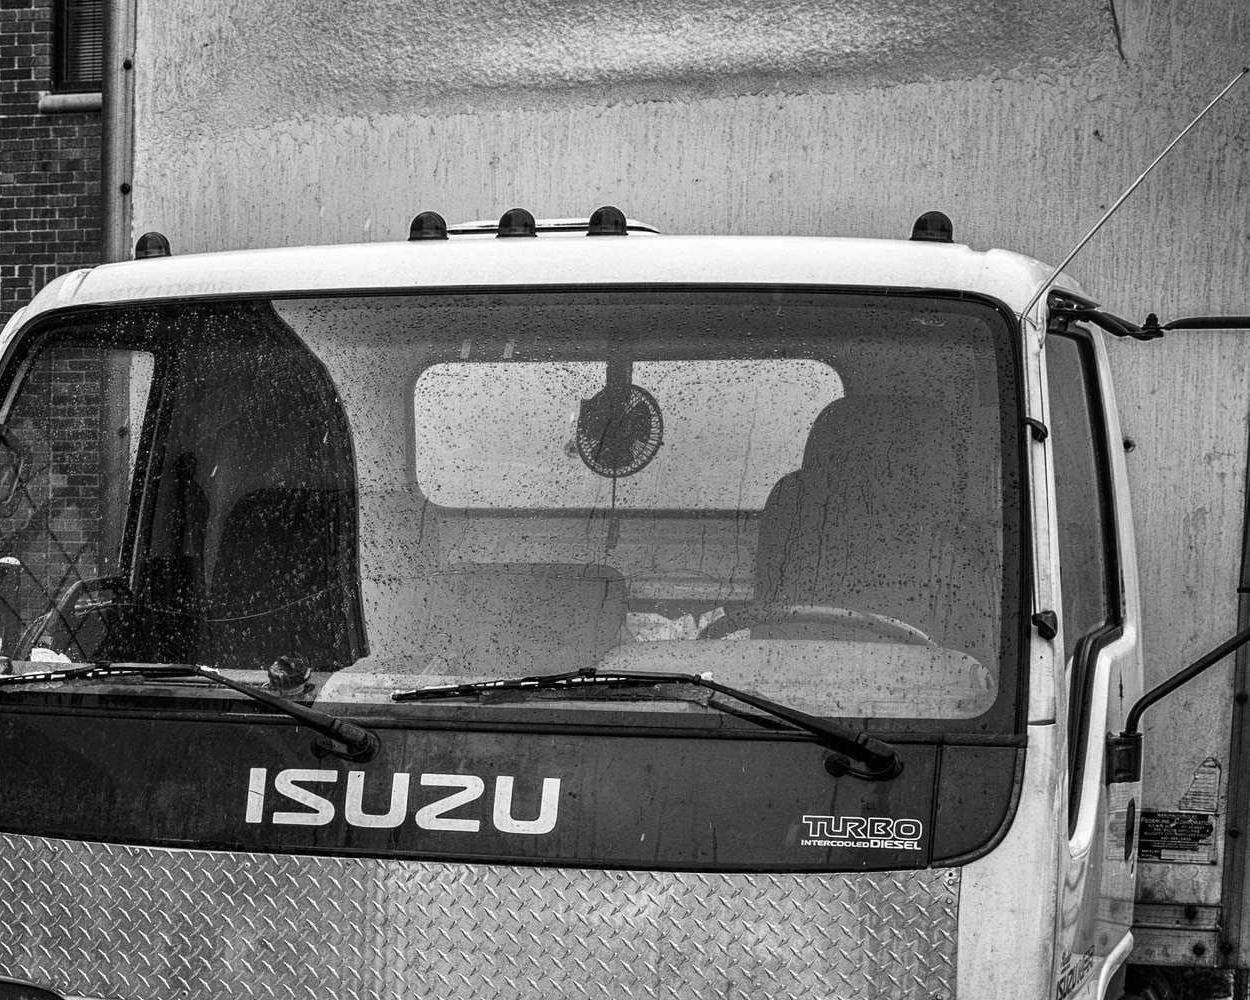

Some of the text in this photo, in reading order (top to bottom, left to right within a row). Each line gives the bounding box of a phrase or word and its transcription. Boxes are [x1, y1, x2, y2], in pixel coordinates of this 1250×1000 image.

[245, 767, 561, 834] ISUZU
[802, 815, 922, 840] TURBO
[800, 839, 922, 850] INTERCOOLED DIESEL
